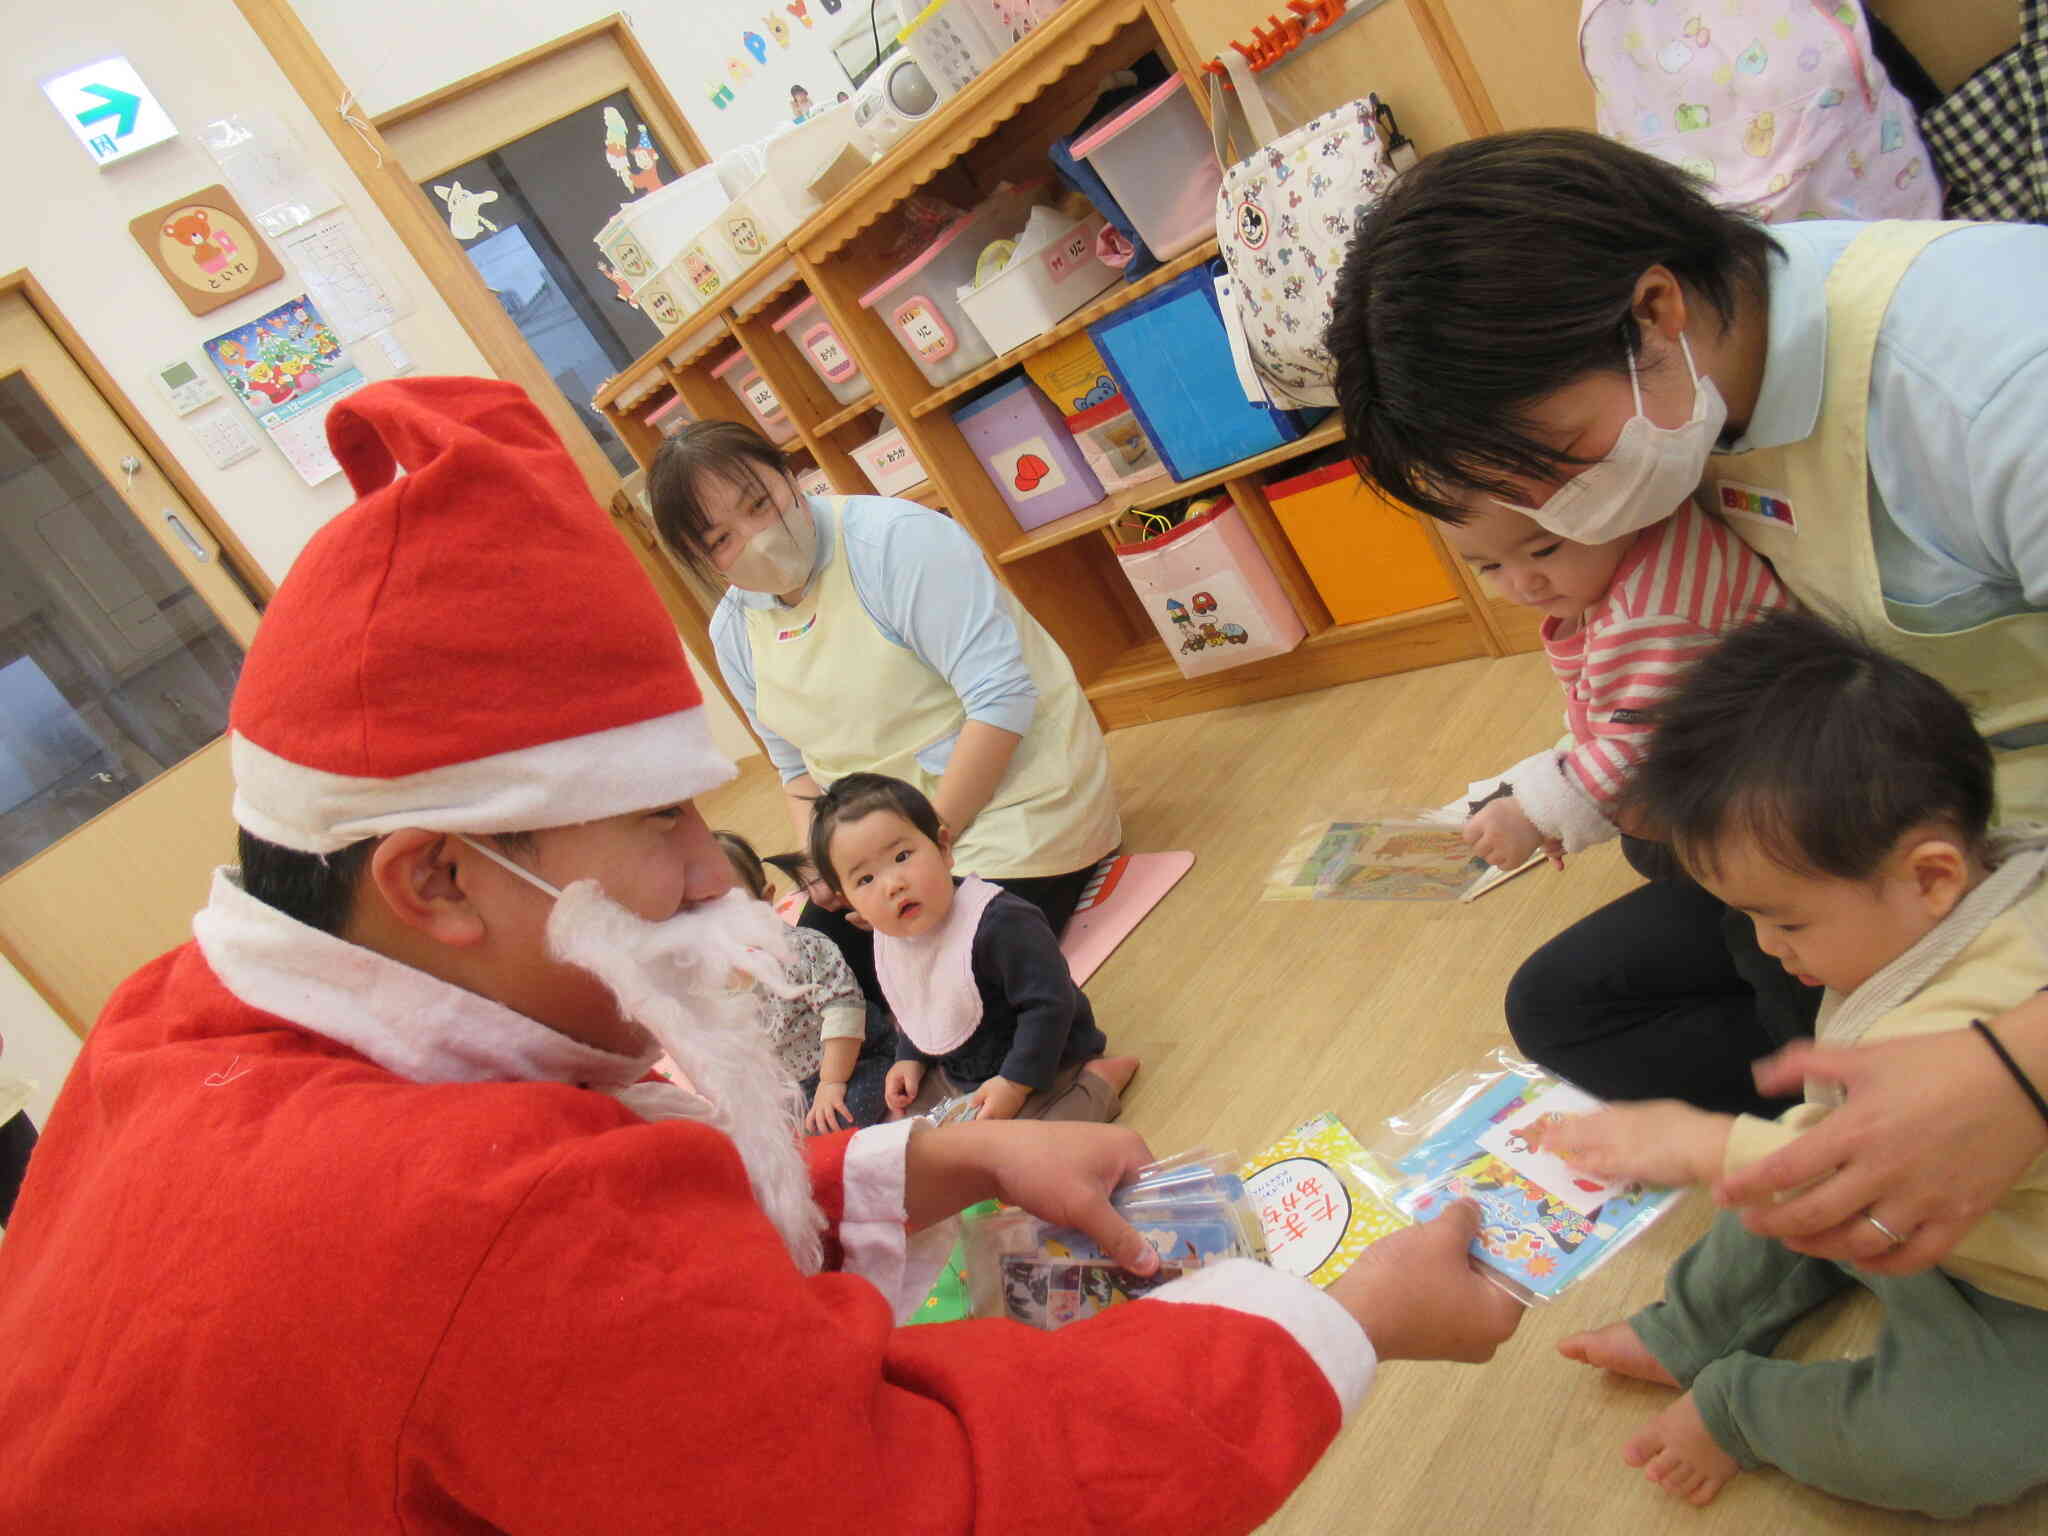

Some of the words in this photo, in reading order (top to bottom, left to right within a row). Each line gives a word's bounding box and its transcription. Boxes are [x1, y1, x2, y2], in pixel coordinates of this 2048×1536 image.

[208, 262, 249, 289] といれ
[916, 324, 932, 340] りこ
